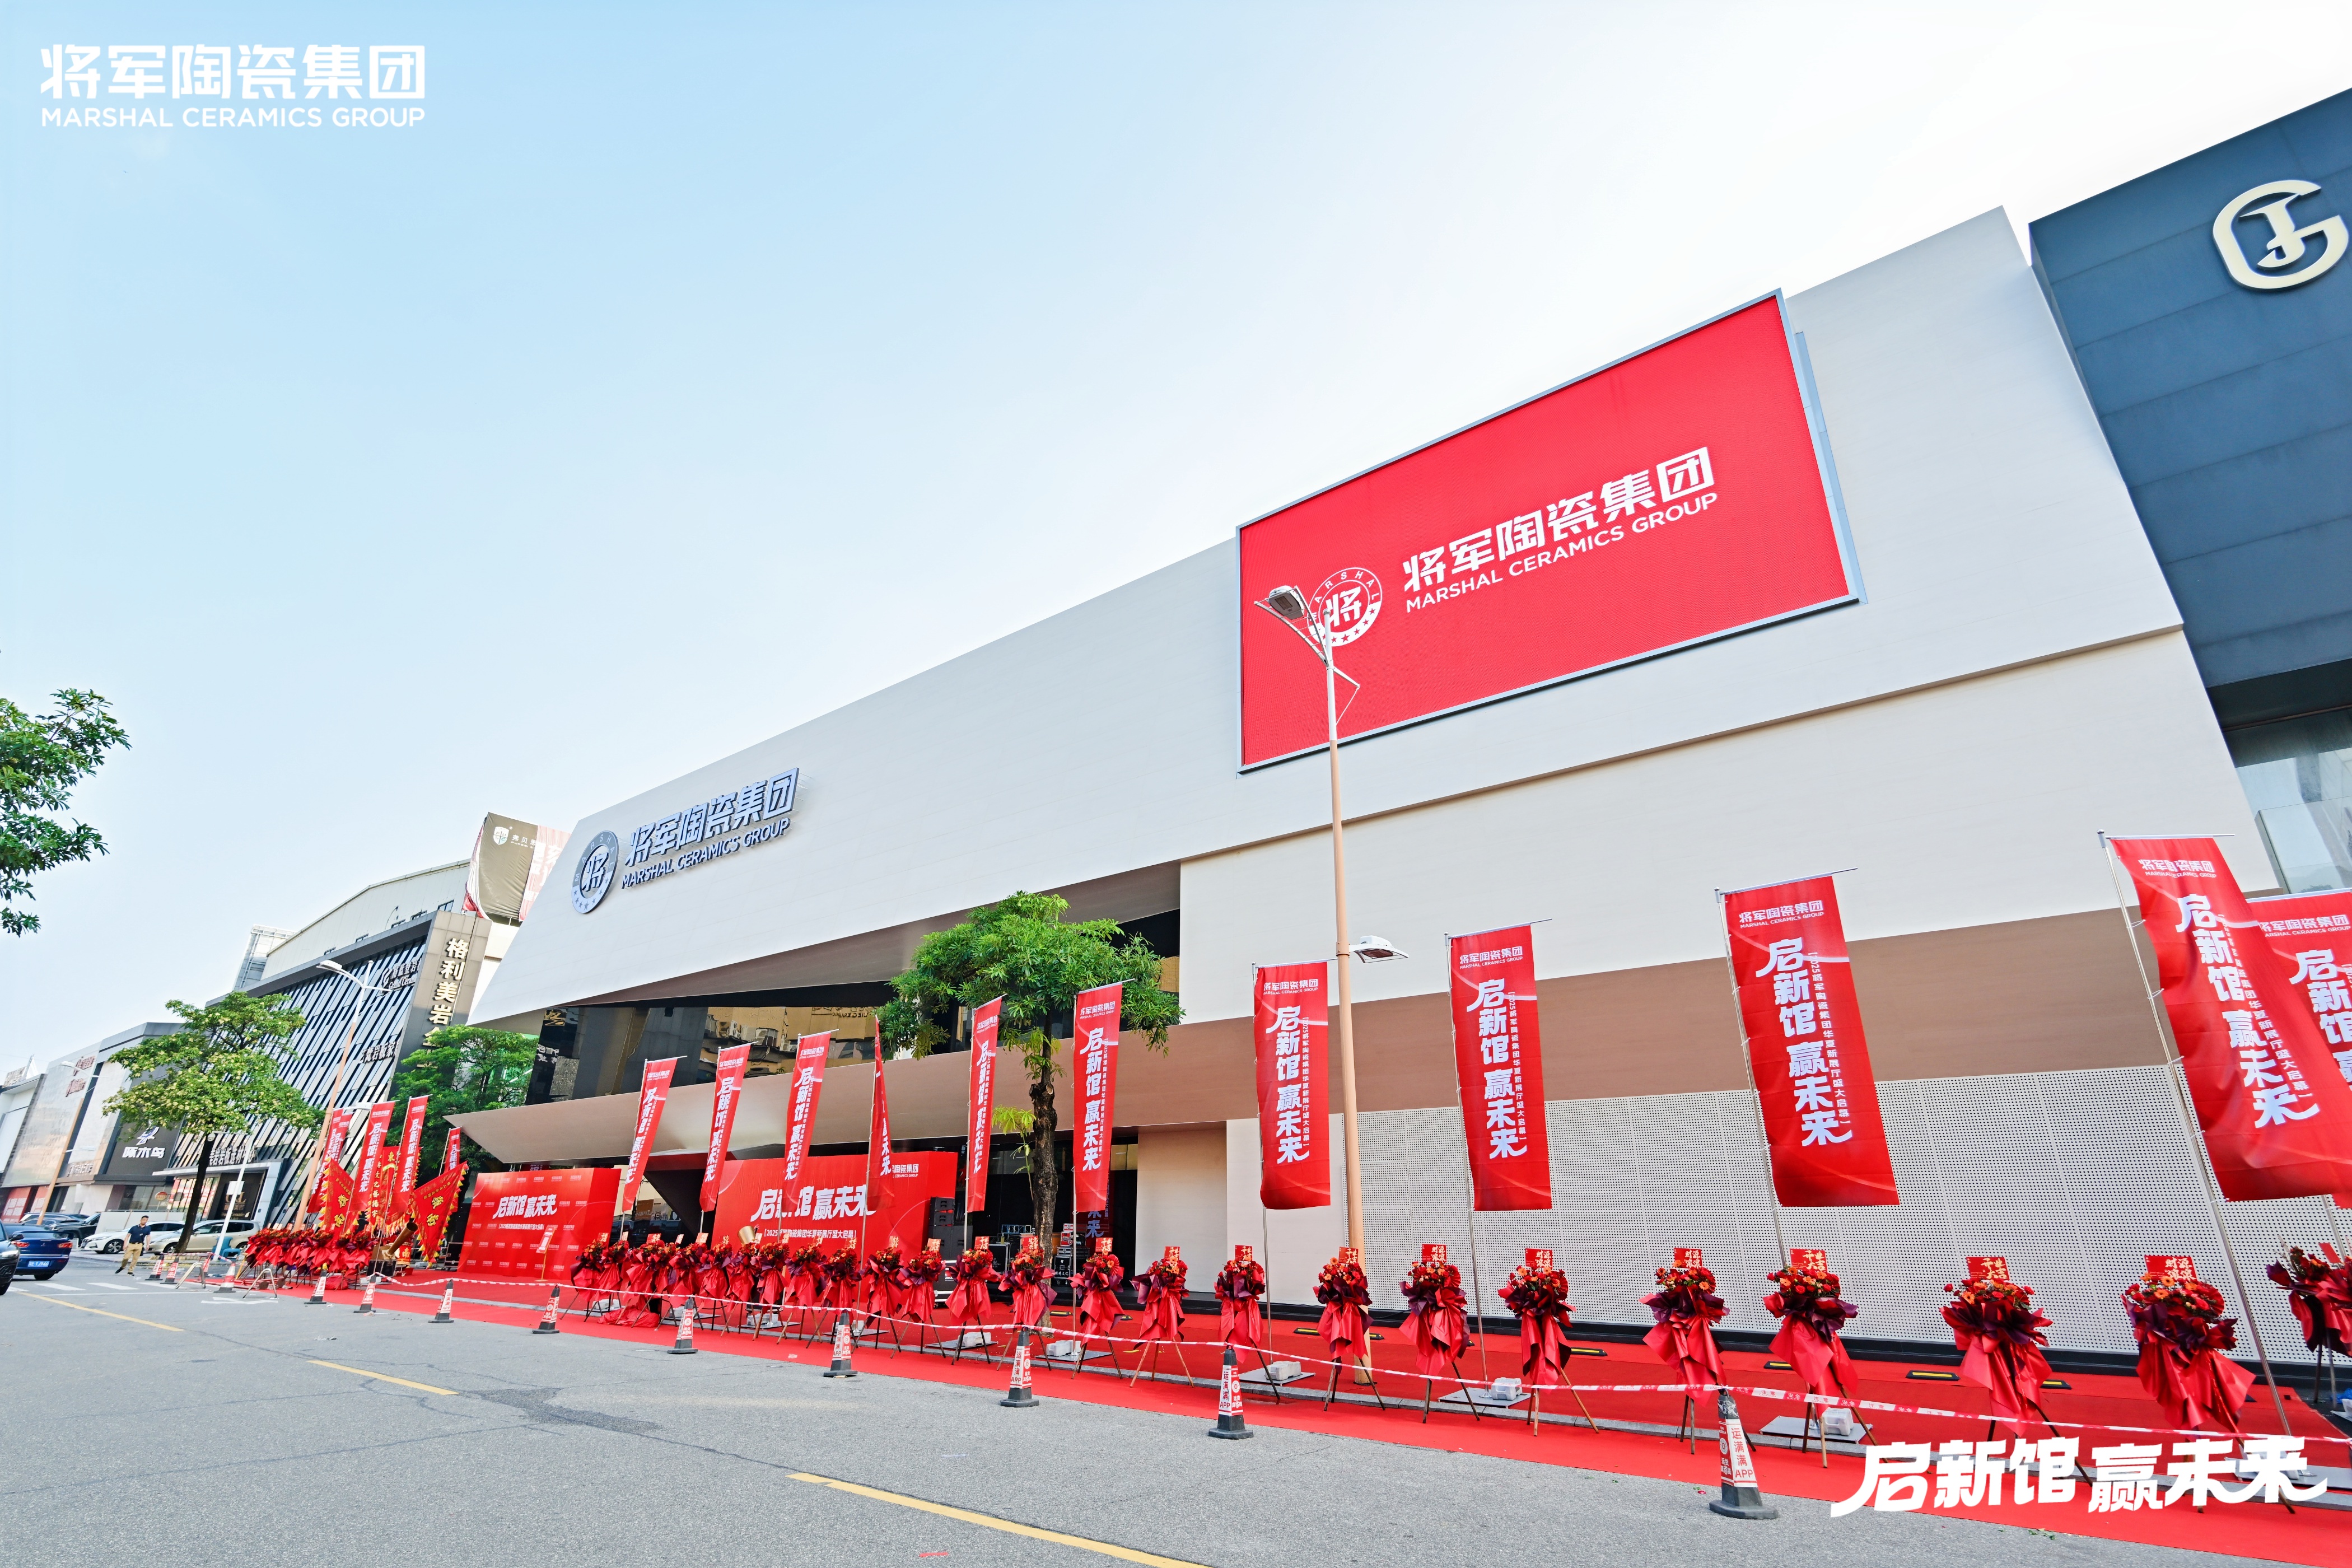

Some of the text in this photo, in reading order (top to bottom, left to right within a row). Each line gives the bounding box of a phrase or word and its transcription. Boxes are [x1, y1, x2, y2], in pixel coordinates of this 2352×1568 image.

[1403, 446, 1715, 592] 将军陶瓷集团
[1406, 492, 1718, 613] MARSHAL CERAMICS GROUP
[625, 767, 799, 867] 将军陶瓷集团
[581, 852, 609, 892] 将
[622, 817, 790, 889] MARSHAL CERAMICS GROUP
[2138, 859, 2215, 873] 将军陶瓷集团
[1739, 900, 1823, 923] 将军陶瓷集团
[1740, 912, 1824, 929] MARSHAL CERAMICS GROUP
[1460, 946, 1523, 964] 将军陶瓷集团
[1264, 979, 1318, 991] 将军陶瓷集团
[2175, 893, 2321, 1128] 启新馆 赢未来
[1467, 978, 1527, 1159] 启新馆 赢未来
[1755, 936, 1853, 1147] 启新馆 赢未来
[1080, 1027, 1104, 1172] 启新馆 赢未来
[1266, 1005, 1310, 1164] 启新馆 赢未来
[785, 1067, 814, 1180] 启新馆 赢未来
[122, 1146, 166, 1158] 啄木鸟
[492, 1194, 557, 1219] 启新馆 赢未来
[1732, 1427, 1747, 1466] 运满满
[1735, 1469, 1753, 1478] APP
